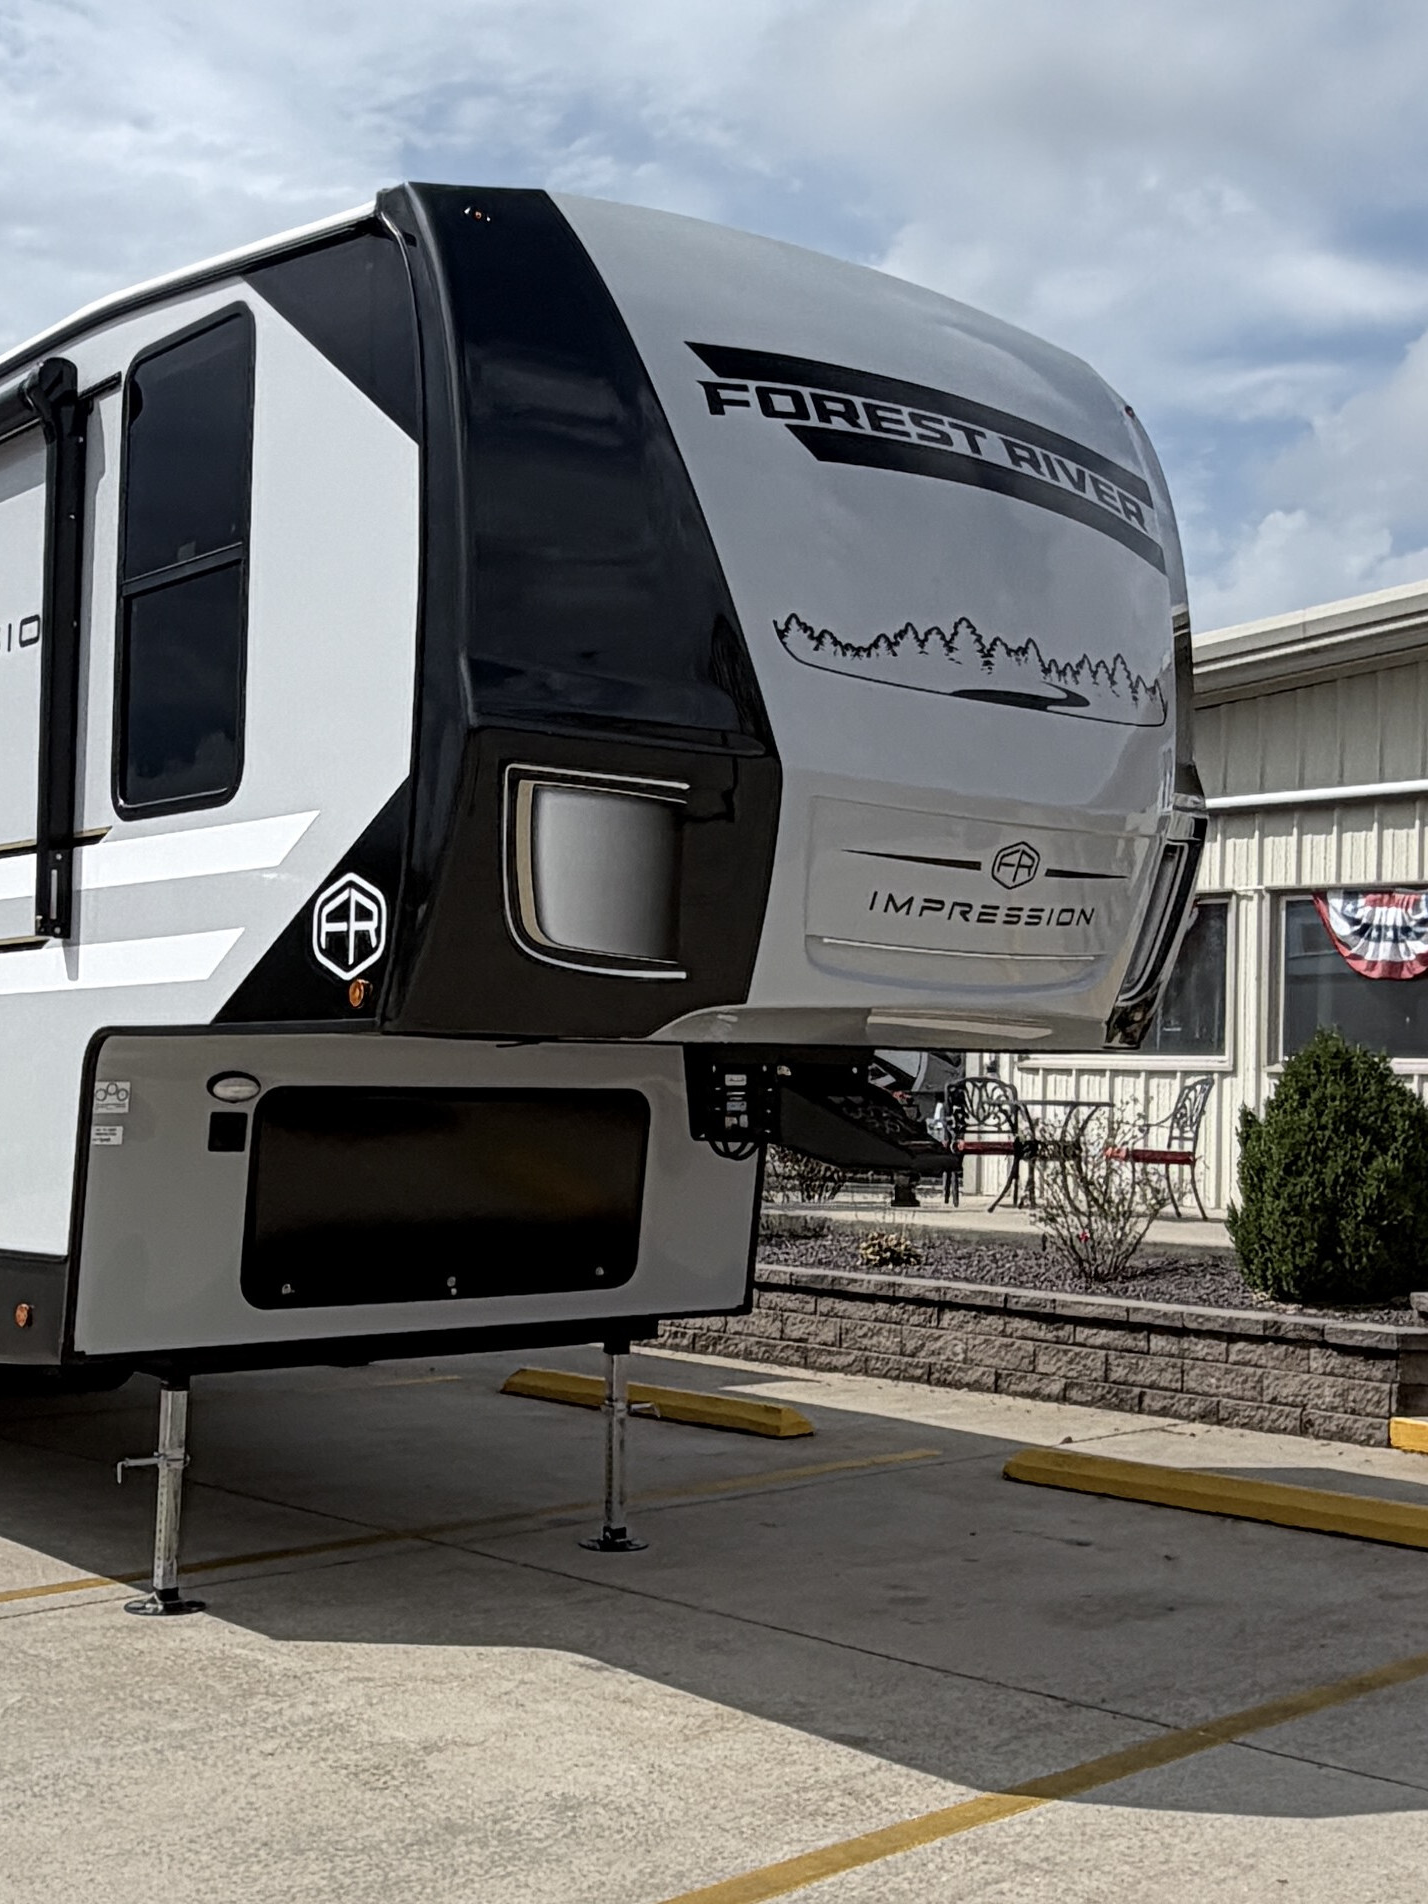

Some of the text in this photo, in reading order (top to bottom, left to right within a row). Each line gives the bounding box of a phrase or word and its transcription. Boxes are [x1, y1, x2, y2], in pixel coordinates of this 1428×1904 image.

[695, 380, 1149, 534] FOREST RIVER
[867, 889, 1097, 928] IMPRESSION
